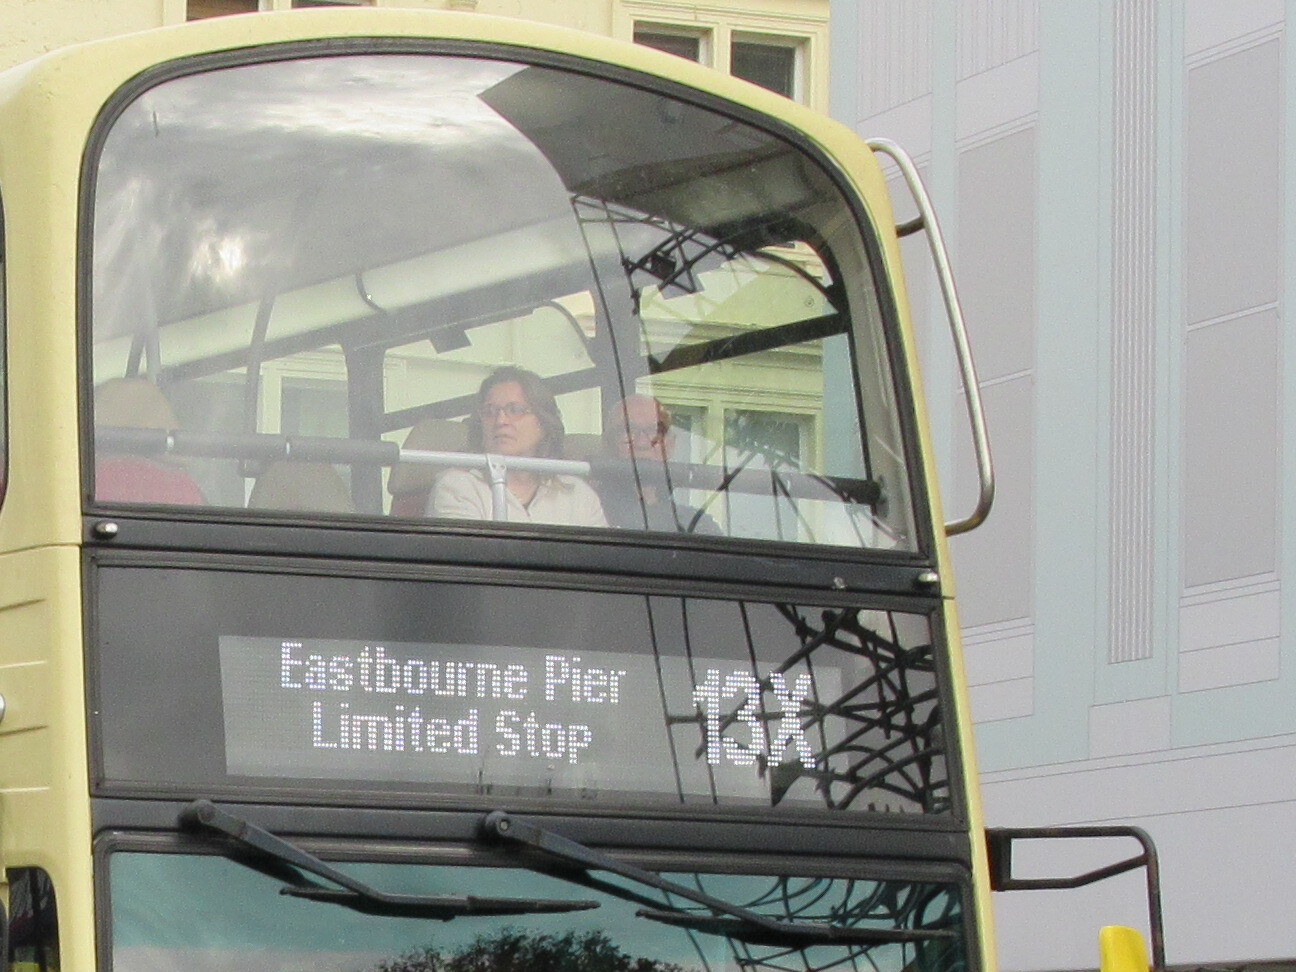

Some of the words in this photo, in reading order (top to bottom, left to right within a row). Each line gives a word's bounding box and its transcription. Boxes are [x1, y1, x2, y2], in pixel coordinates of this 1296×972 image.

[280, 640, 529, 699] Eastbourne
[545, 654, 628, 703] Pier
[312, 701, 479, 754] Limited
[495, 709, 593, 765] Stop
[692, 668, 816, 769] 13X
